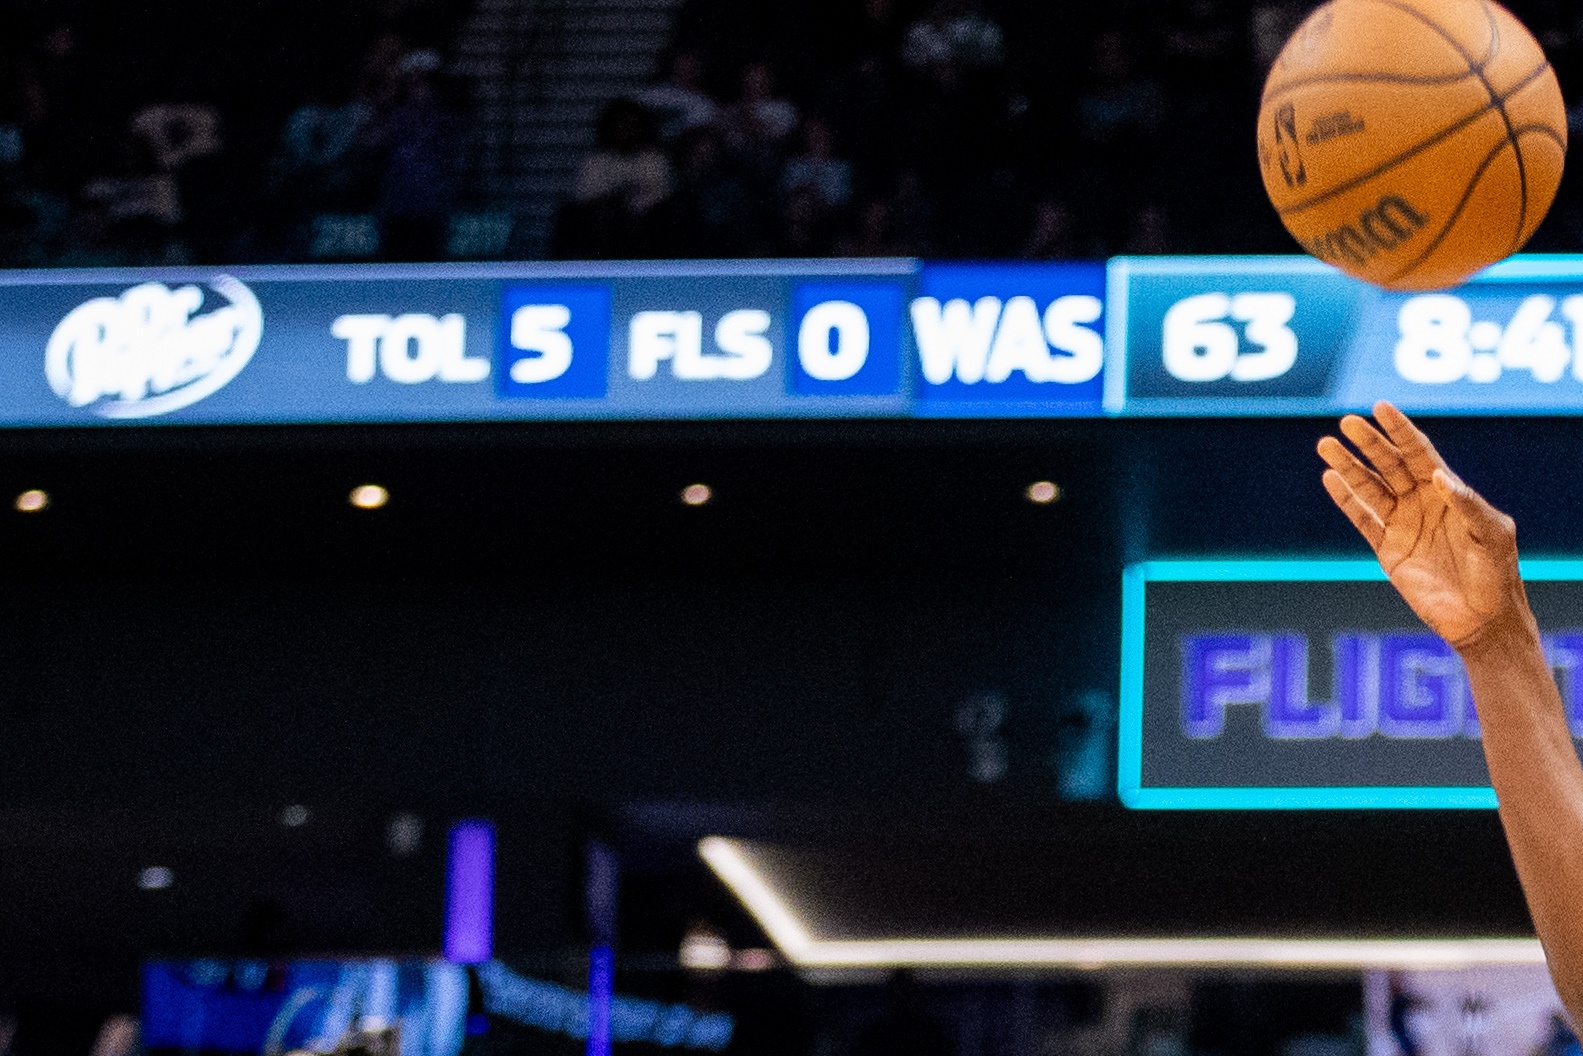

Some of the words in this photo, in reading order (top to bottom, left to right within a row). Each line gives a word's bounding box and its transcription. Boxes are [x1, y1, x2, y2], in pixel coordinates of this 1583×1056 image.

[330, 313, 491, 384] TOL
[510, 304, 573, 383] 5
[627, 309, 774, 381] FLS
[797, 300, 870, 381] 0
[909, 294, 1105, 385] WAS
[1161, 291, 1299, 383] 63
